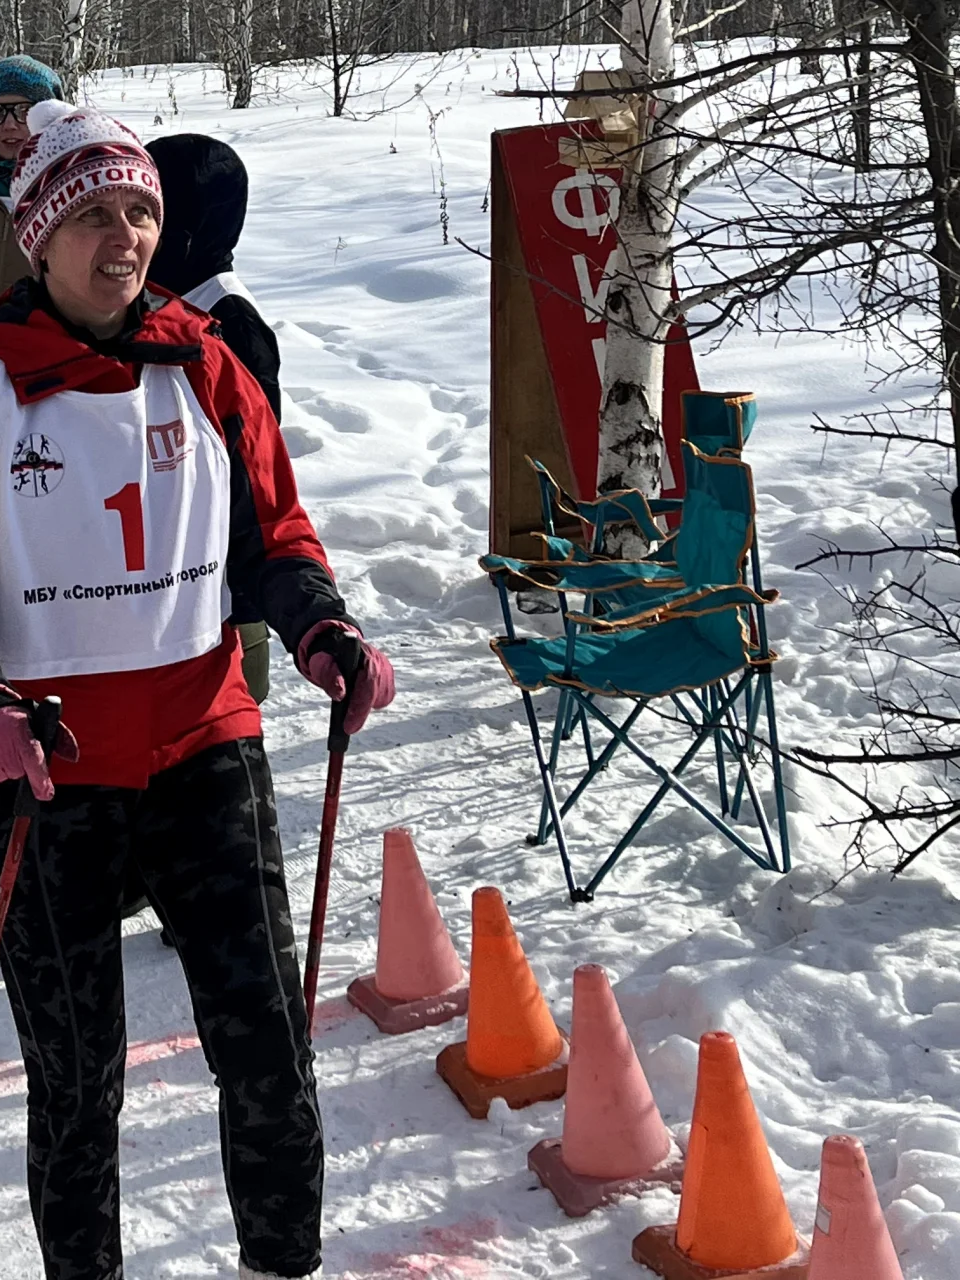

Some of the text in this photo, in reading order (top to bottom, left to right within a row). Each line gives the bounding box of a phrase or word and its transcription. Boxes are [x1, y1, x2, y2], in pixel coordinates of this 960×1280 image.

[103, 482, 146, 572] 1
[23, 586, 58, 606] МБУ
[63, 573, 175, 602] «Спортивный
